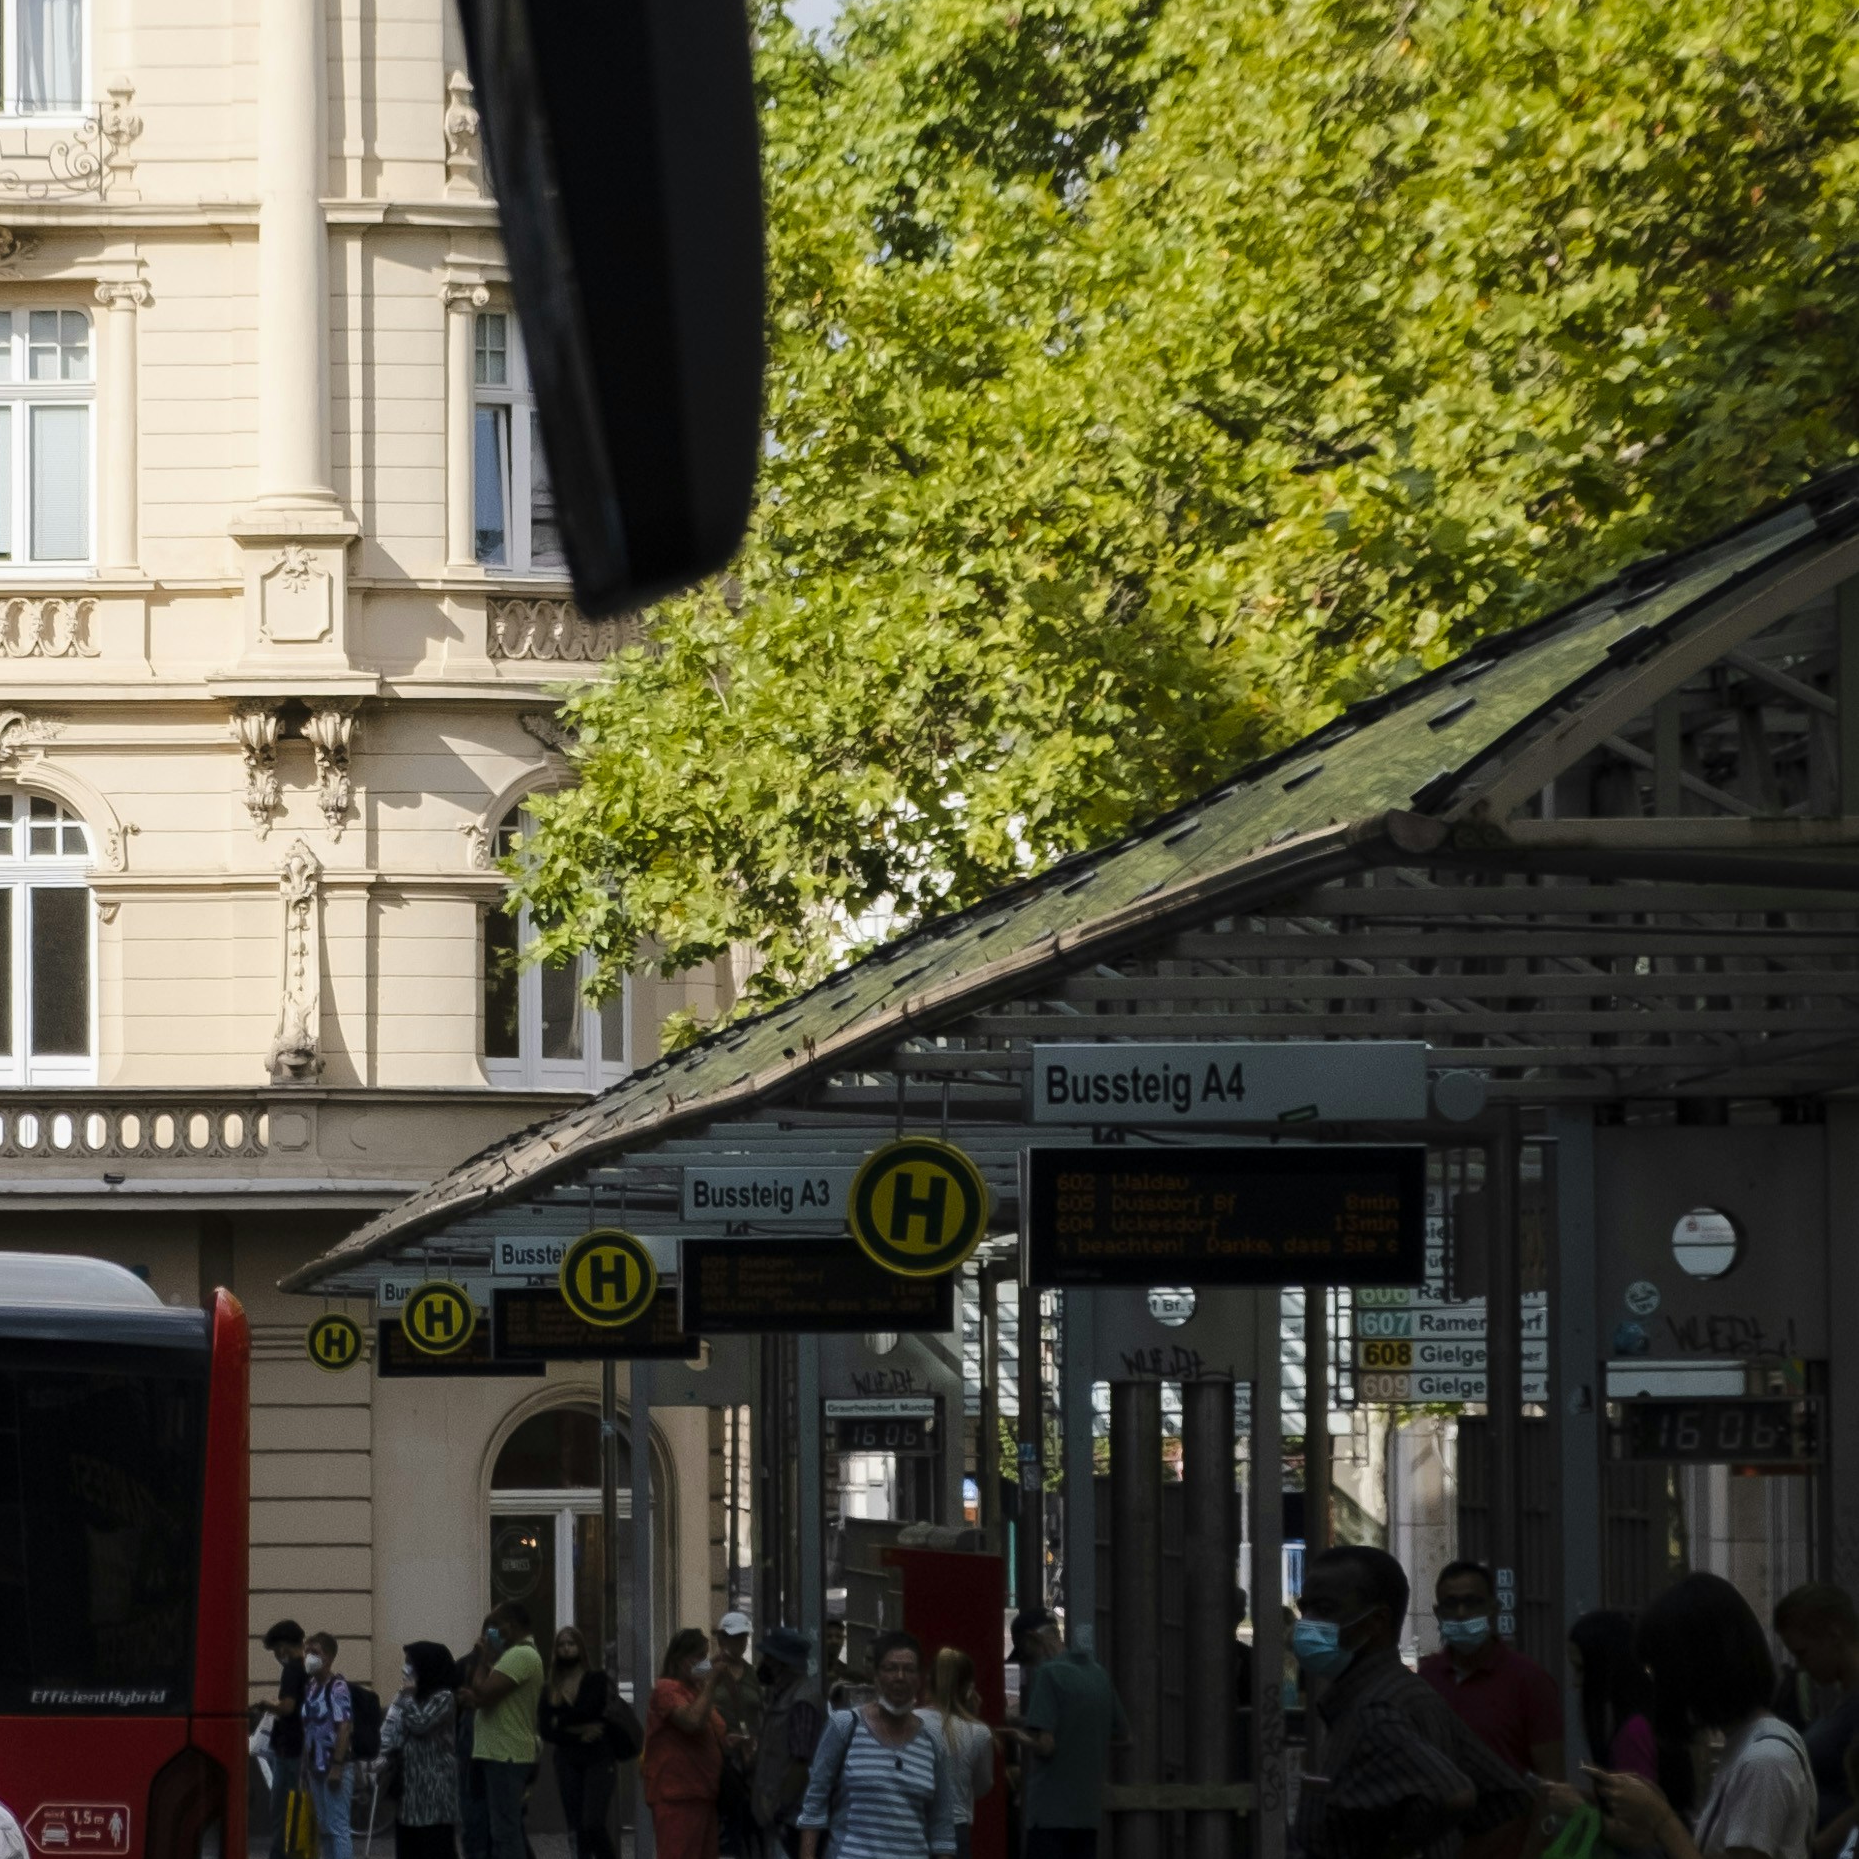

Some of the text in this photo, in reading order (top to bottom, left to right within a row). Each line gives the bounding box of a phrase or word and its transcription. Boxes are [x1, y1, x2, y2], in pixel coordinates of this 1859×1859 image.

[1046, 1062, 1246, 1113] Bussteig A4
[693, 1179, 831, 1214] Bussteig A3
[891, 1172, 948, 1246] H
[502, 1243, 568, 1265] Busstei
[591, 1254, 627, 1304] H
[424, 1300, 454, 1337] H
[1362, 1313, 1411, 1336] 607
[324, 1328, 347, 1359] H
[1364, 1343, 1412, 1366] 608
[1420, 1345, 1487, 1367] Gielge
[1418, 1376, 1486, 1399] Gielge
[30, 1689, 167, 1706] EfficientHybrid
[73, 1809, 93, 1826] 1,5
